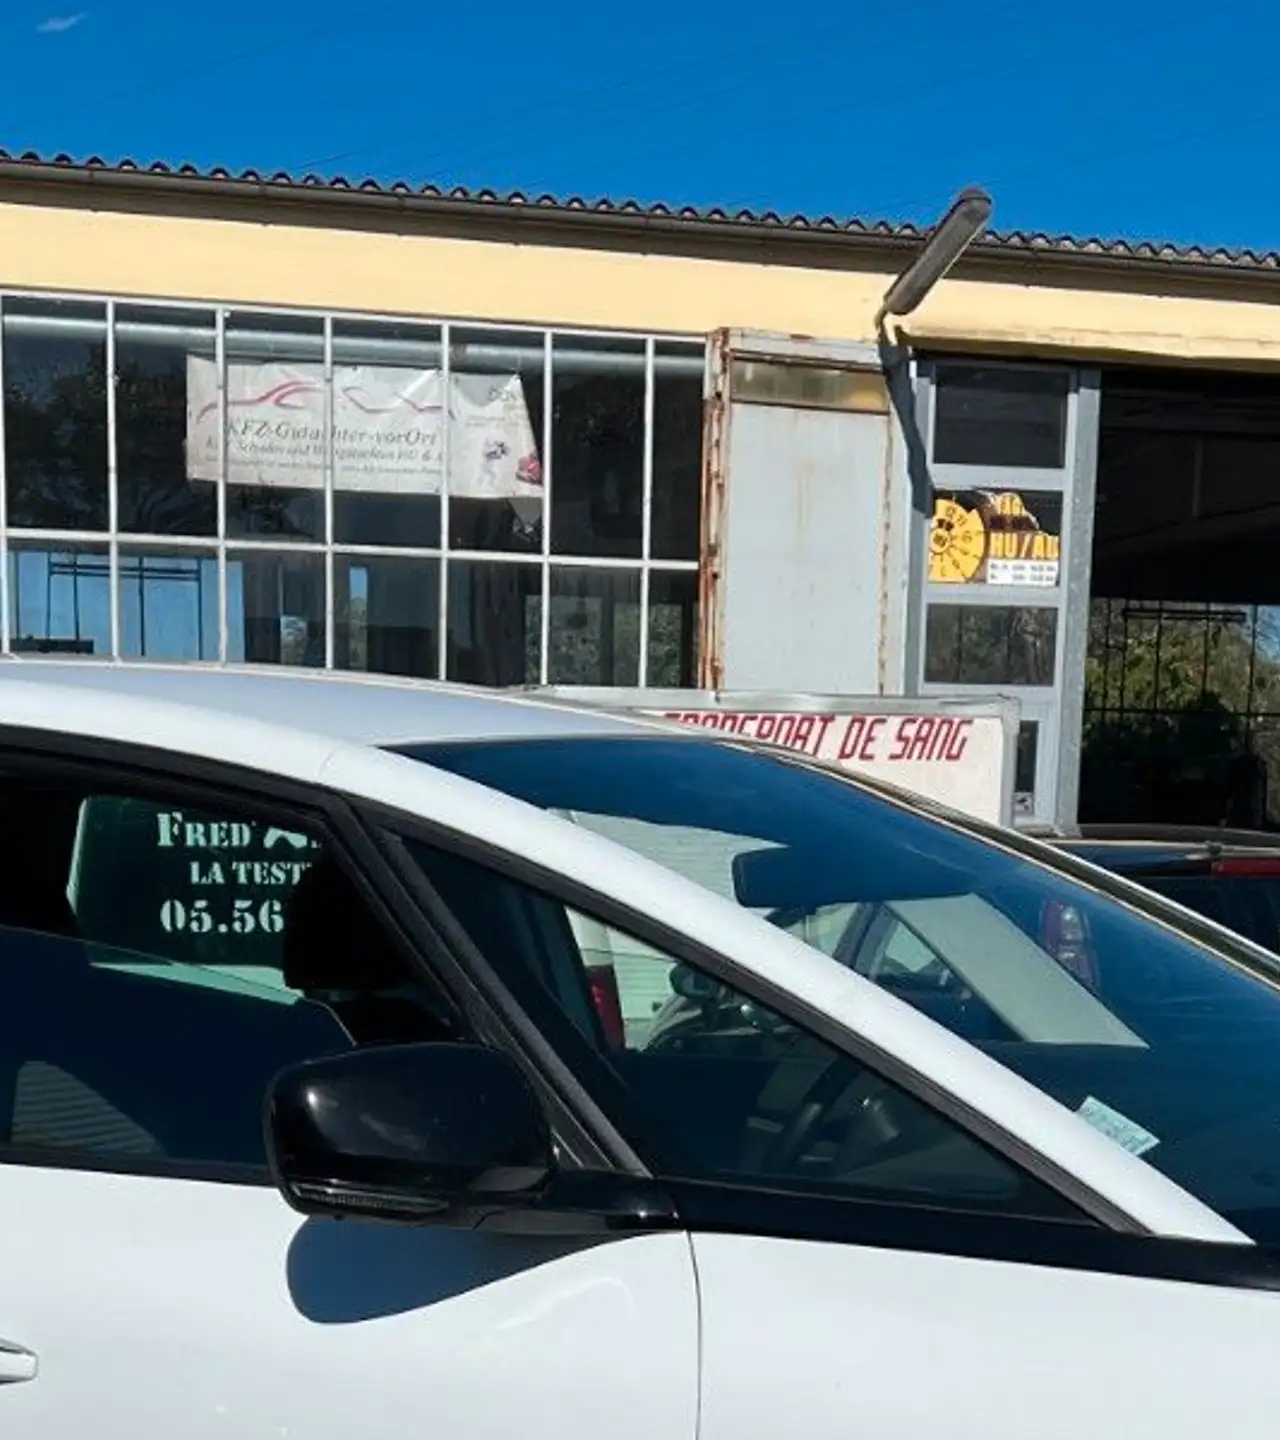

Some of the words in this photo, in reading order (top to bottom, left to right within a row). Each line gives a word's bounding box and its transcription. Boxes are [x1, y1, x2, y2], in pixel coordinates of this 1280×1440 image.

[837, 717, 888, 760] DE
[888, 718, 973, 763] SANG
[190, 860, 225, 885] LA
[232, 860, 313, 885] TEST
[159, 899, 284, 934] 05.56
